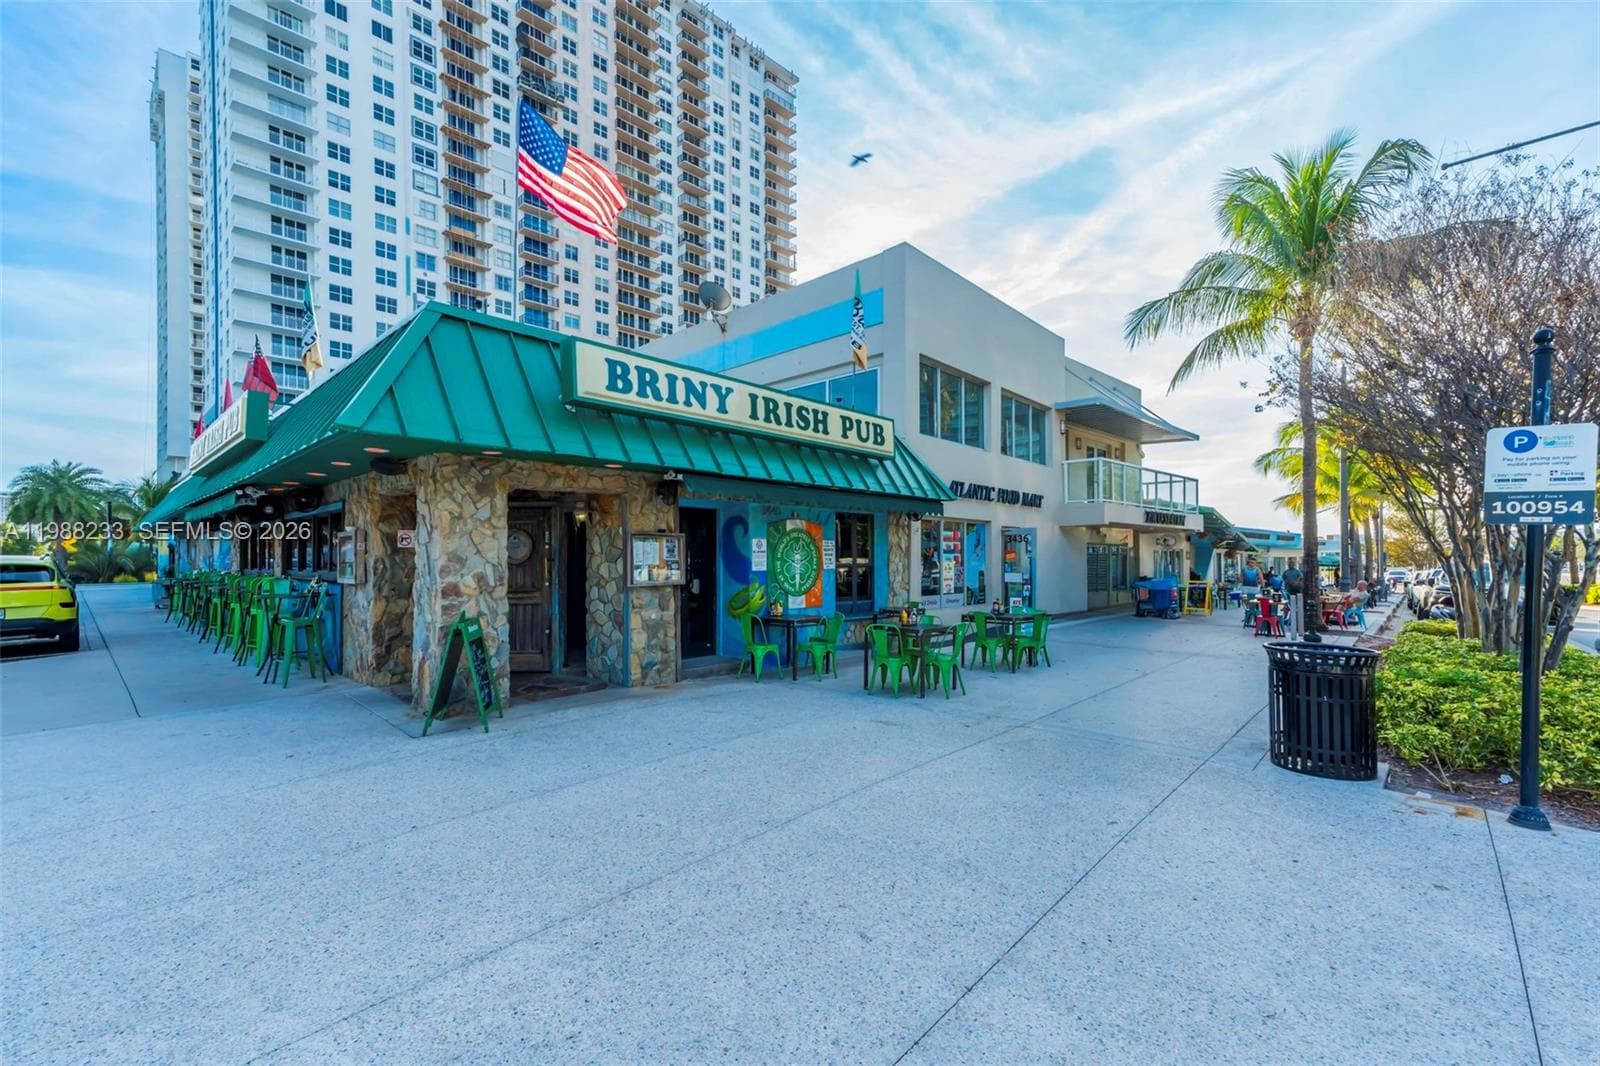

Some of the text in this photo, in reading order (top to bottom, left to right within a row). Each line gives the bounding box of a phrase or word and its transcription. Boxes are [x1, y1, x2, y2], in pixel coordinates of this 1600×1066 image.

[604, 356, 886, 447] BRINY IRISH PUB
[1514, 435, 1529, 449] P
[949, 479, 1044, 508] ATLANTIC FOOD MART
[1492, 500, 1585, 514] 100954
[1006, 534, 1030, 544] 3436
